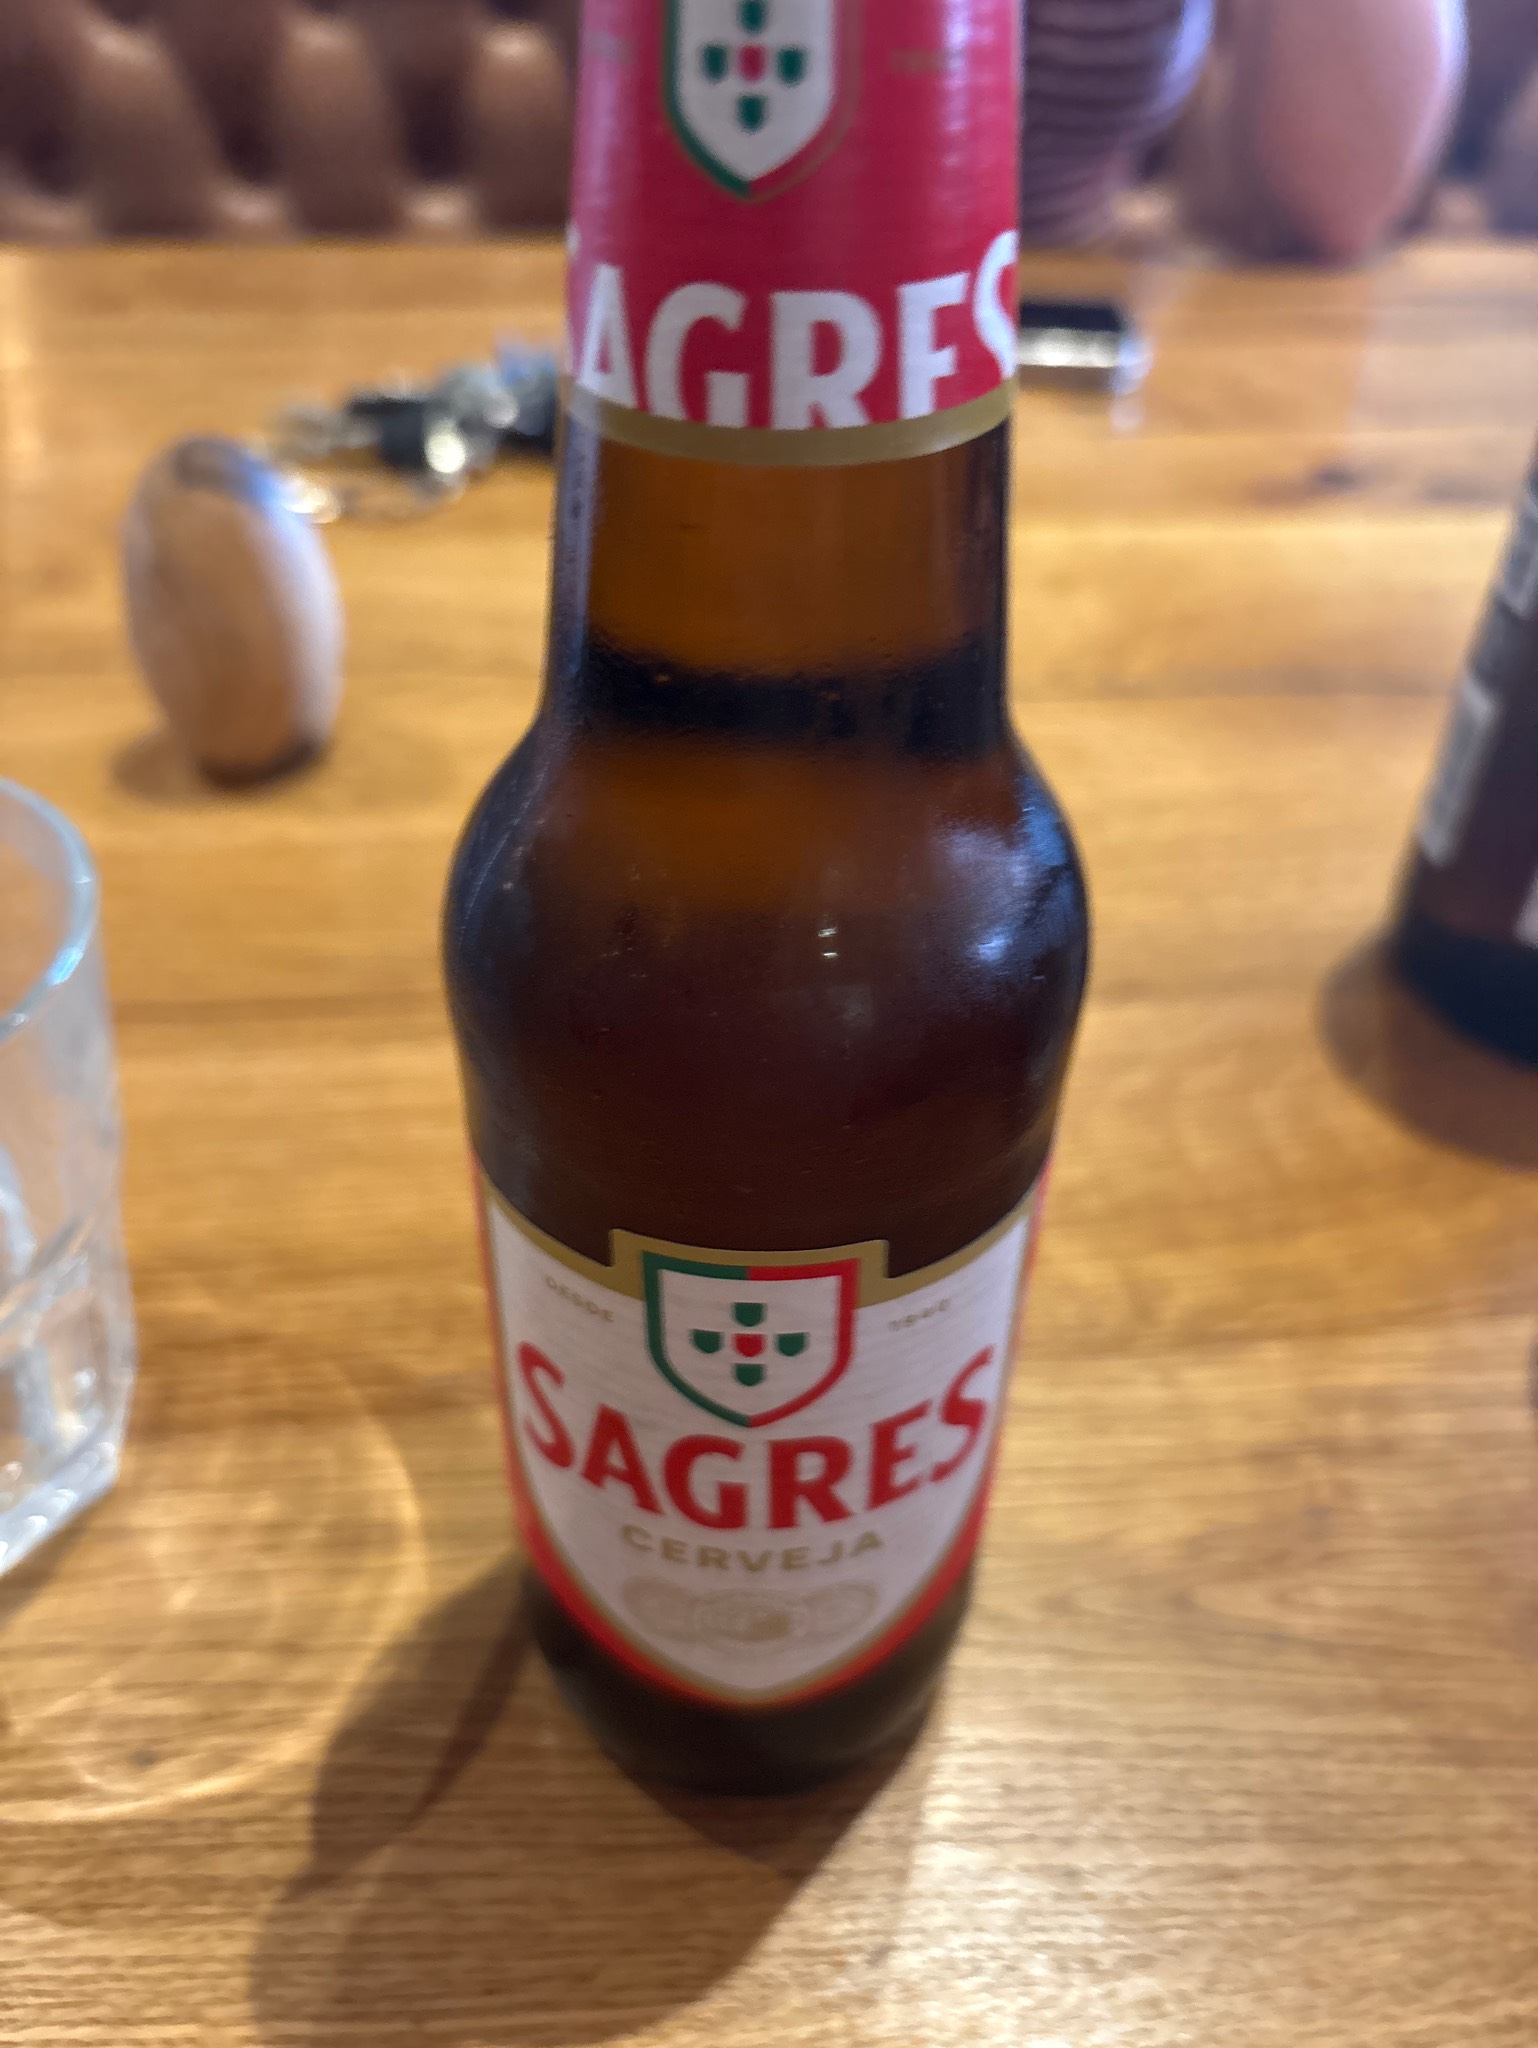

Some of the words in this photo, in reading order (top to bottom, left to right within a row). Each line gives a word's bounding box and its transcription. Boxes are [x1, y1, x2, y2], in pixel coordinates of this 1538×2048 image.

[565, 224, 1018, 430] AGRES
[517, 1341, 994, 1529] SAGRES
[620, 1524, 884, 1572] CERVEJA
